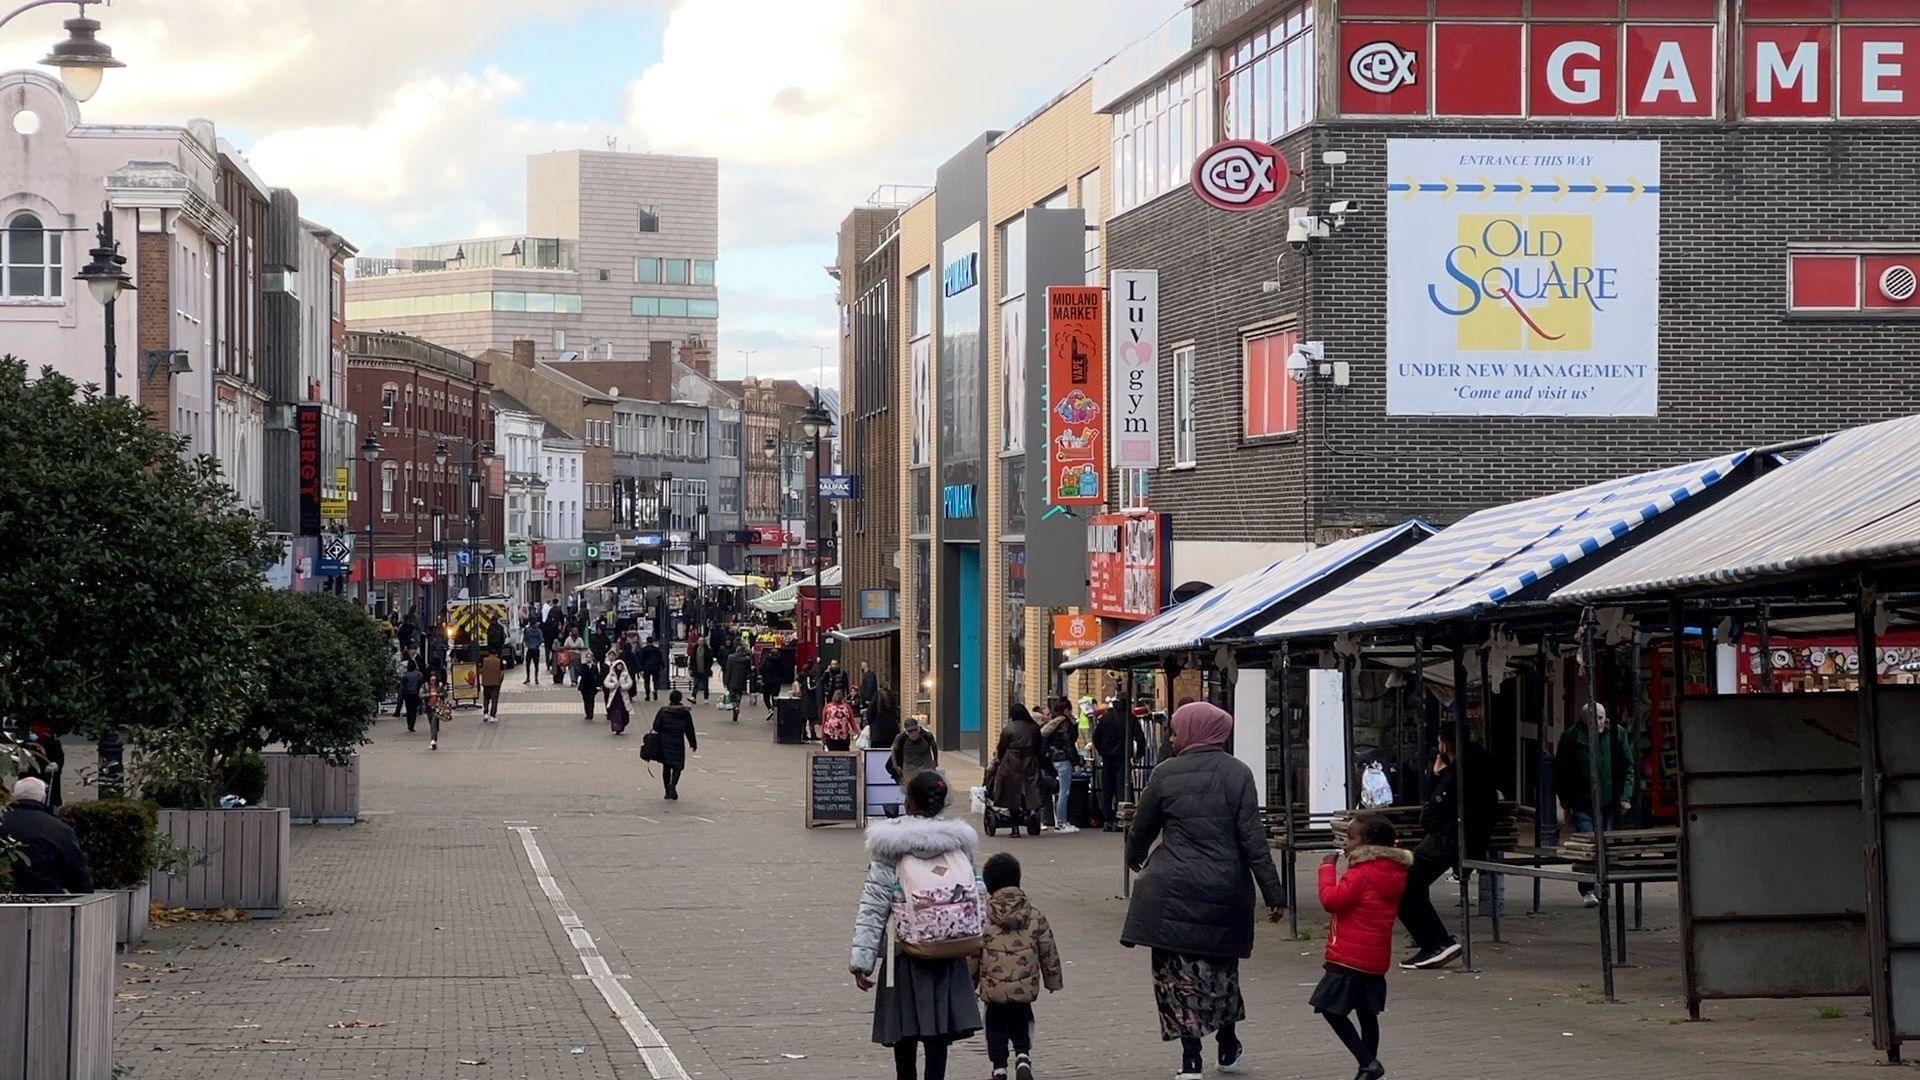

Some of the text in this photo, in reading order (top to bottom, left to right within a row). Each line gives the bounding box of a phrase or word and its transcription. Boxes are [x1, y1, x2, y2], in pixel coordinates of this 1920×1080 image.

[1459, 154, 1594, 167] ENTRANCE THIS WAY
[1482, 218, 1563, 258] OLD
[1052, 293, 1098, 306] MIDLAND
[1428, 245, 1619, 341] SQUARE
[1052, 307, 1098, 320] MARKET
[1073, 356, 1084, 381] VAPE
[1398, 362, 1648, 379] UNDER NEW MANAGEMENT
[1505, 385, 1535, 401] and
[1537, 385, 1568, 401] visit
[300, 410, 317, 502] ENERGY
